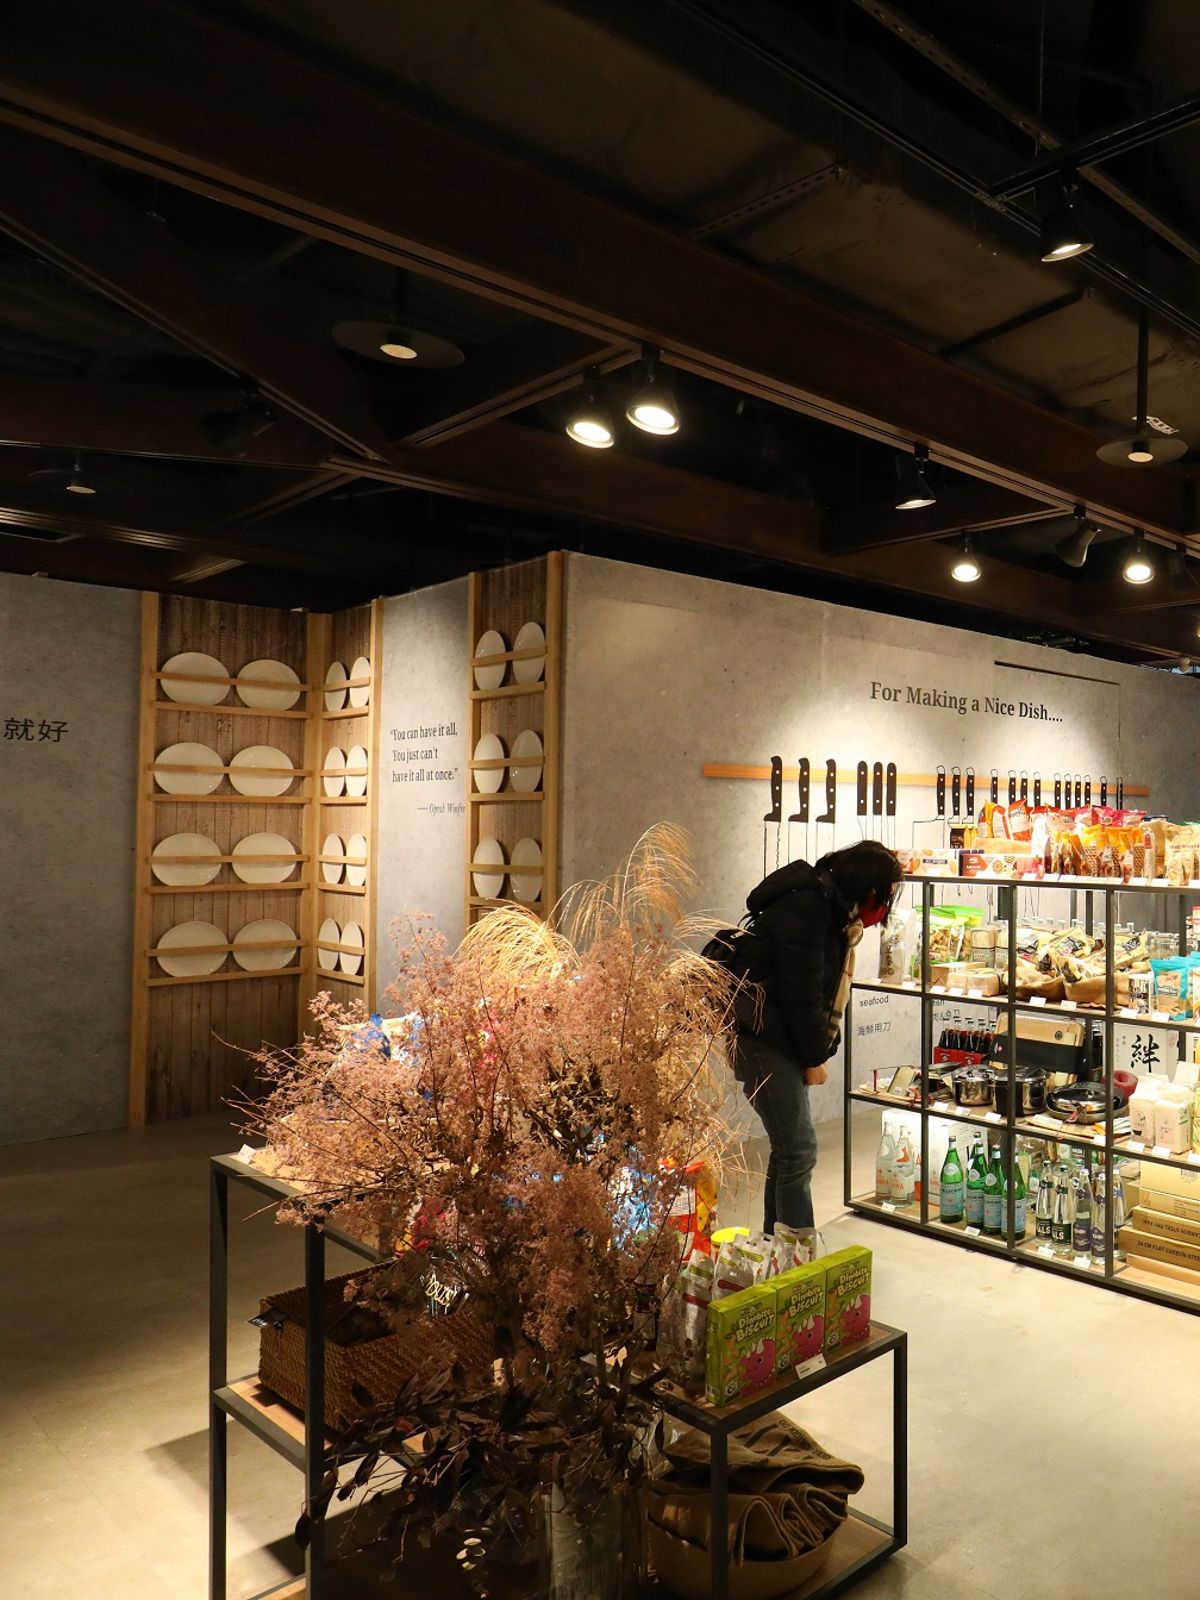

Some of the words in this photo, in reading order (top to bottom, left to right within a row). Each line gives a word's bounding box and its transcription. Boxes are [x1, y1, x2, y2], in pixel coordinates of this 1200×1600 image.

[870, 681, 901, 702] For
[906, 686, 968, 715] Making
[971, 698, 980, 712] a
[984, 697, 1015, 716] Nice
[3, 717, 68, 742] 就好
[407, 730, 419, 740] can
[420, 725, 438, 738] have
[438, 724, 445, 736] it
[393, 750, 406, 761] You
[406, 748, 419, 764] just
[392, 770, 408, 782] have
[416, 768, 425, 781] all
[859, 995, 889, 1007] seafood
